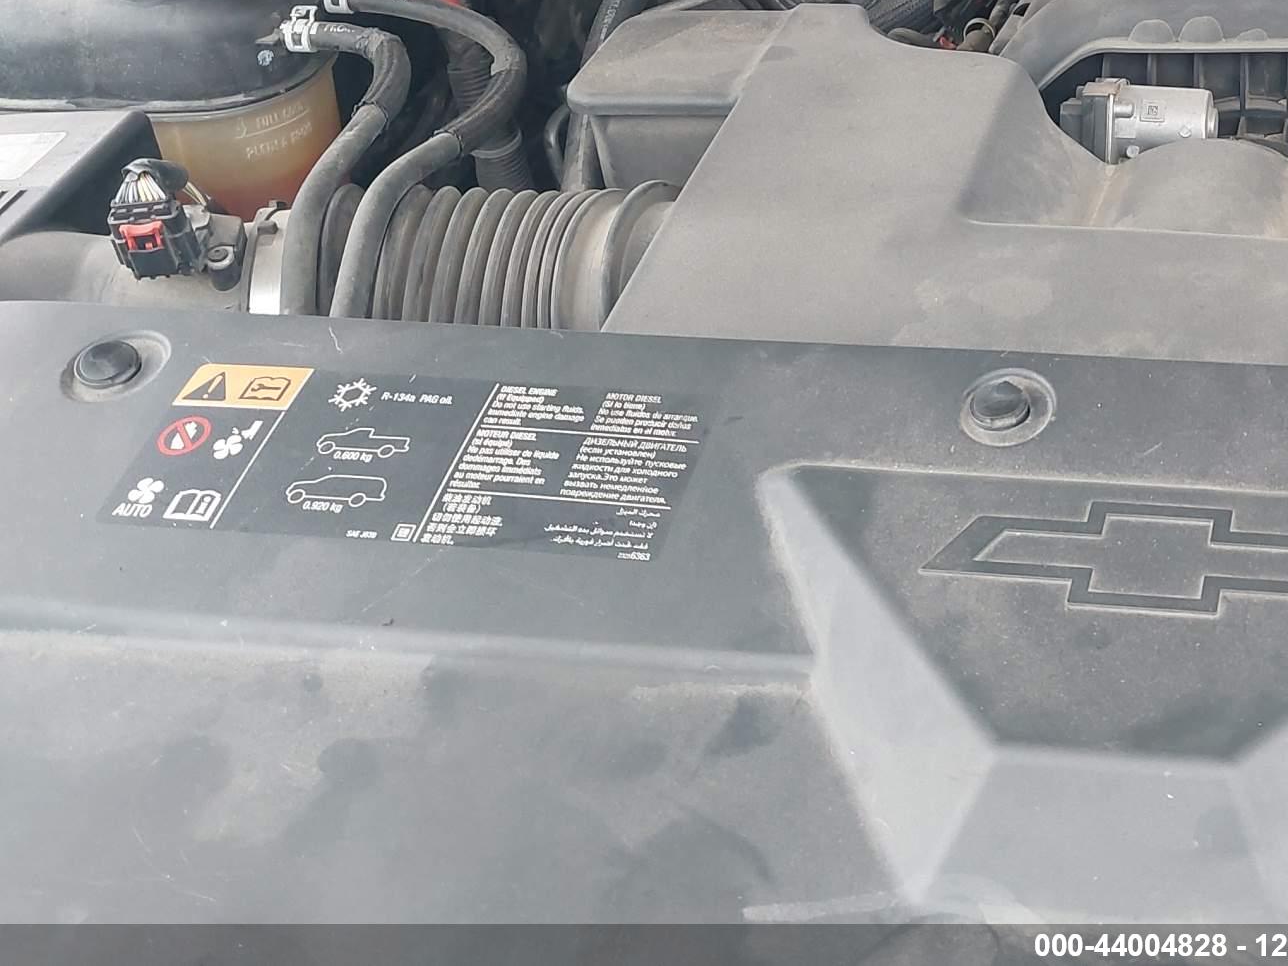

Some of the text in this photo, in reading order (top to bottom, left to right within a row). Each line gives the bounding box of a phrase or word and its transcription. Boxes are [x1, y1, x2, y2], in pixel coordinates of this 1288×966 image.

[501, 385, 558, 396] DIESEL ENGINE
[381, 392, 416, 402] R-134a
[419, 394, 440, 403] PAG
[606, 393, 662, 404] MOTOR DIESEL
[532, 403, 561, 413] starting
[528, 412, 553, 420] engine
[653, 411, 662, 419] de
[594, 415, 605, 423] Se
[635, 419, 667, 427] producir
[476, 429, 536, 441] MOTEUR DIESEL
[583, 437, 688, 452] ДИЗЕЛЬНЫЙ ДВИГАТЕЛЬ
[360, 452, 373, 463] kg
[479, 448, 493, 456] pas
[495, 447, 521, 456] utiliser
[533, 450, 560, 460] liquide
[576, 453, 687, 470] Не используйте пусковые
[458, 462, 501, 473] dommages
[571, 464, 678, 478] жидкости для холодного
[466, 472, 493, 481] moteur
[493, 474, 533, 484] pourraient
[620, 476, 648, 484] может
[564, 480, 598, 488] вызвать
[112, 502, 153, 518] AUTO
[330, 502, 344, 514] kg
